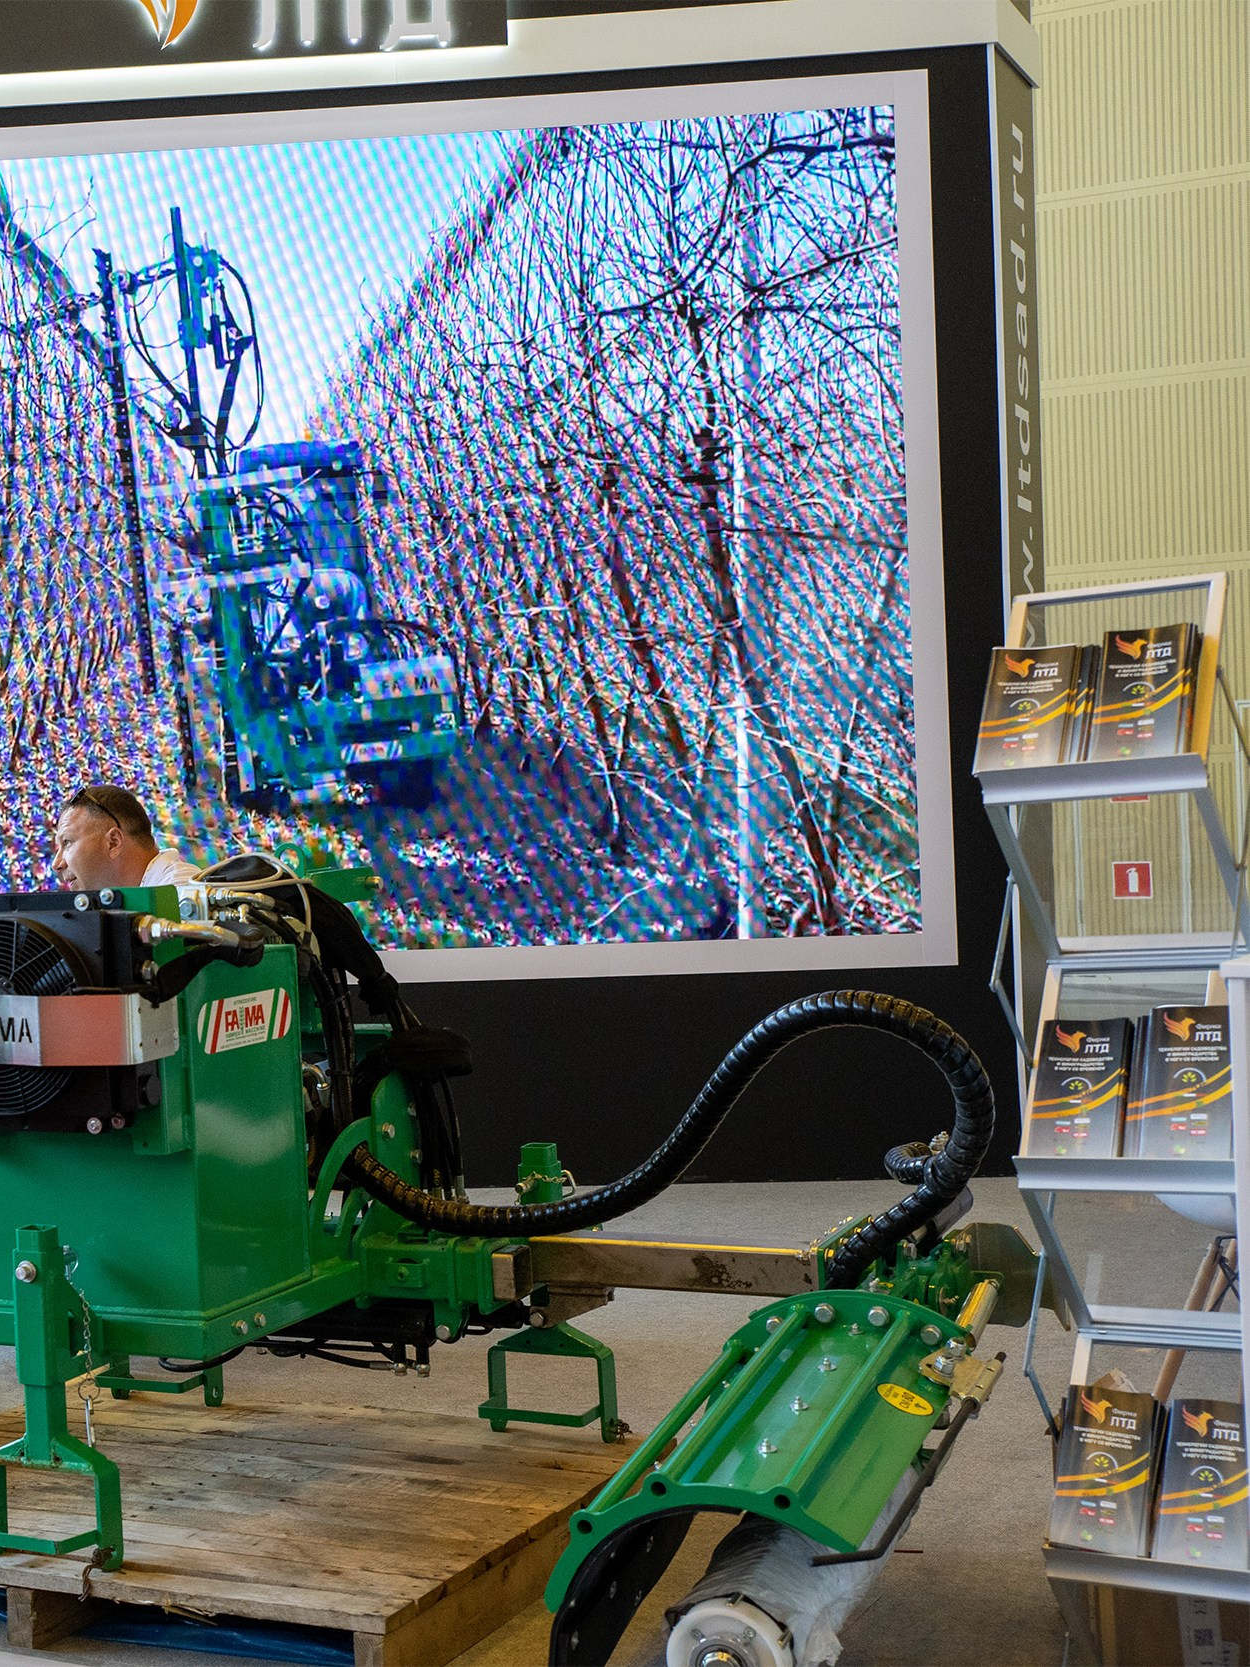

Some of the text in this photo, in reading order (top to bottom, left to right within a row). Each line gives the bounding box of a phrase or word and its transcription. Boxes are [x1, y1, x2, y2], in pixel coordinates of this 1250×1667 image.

[1146, 647, 1171, 659] ЛТД
[1032, 667, 1058, 678] ЛТД
[1194, 1031, 1222, 1042] ЛТД
[1084, 1044, 1109, 1053] ЛТД
[1110, 1416, 1136, 1430] ЛТД
[1212, 1428, 1239, 1442] ЛТД
